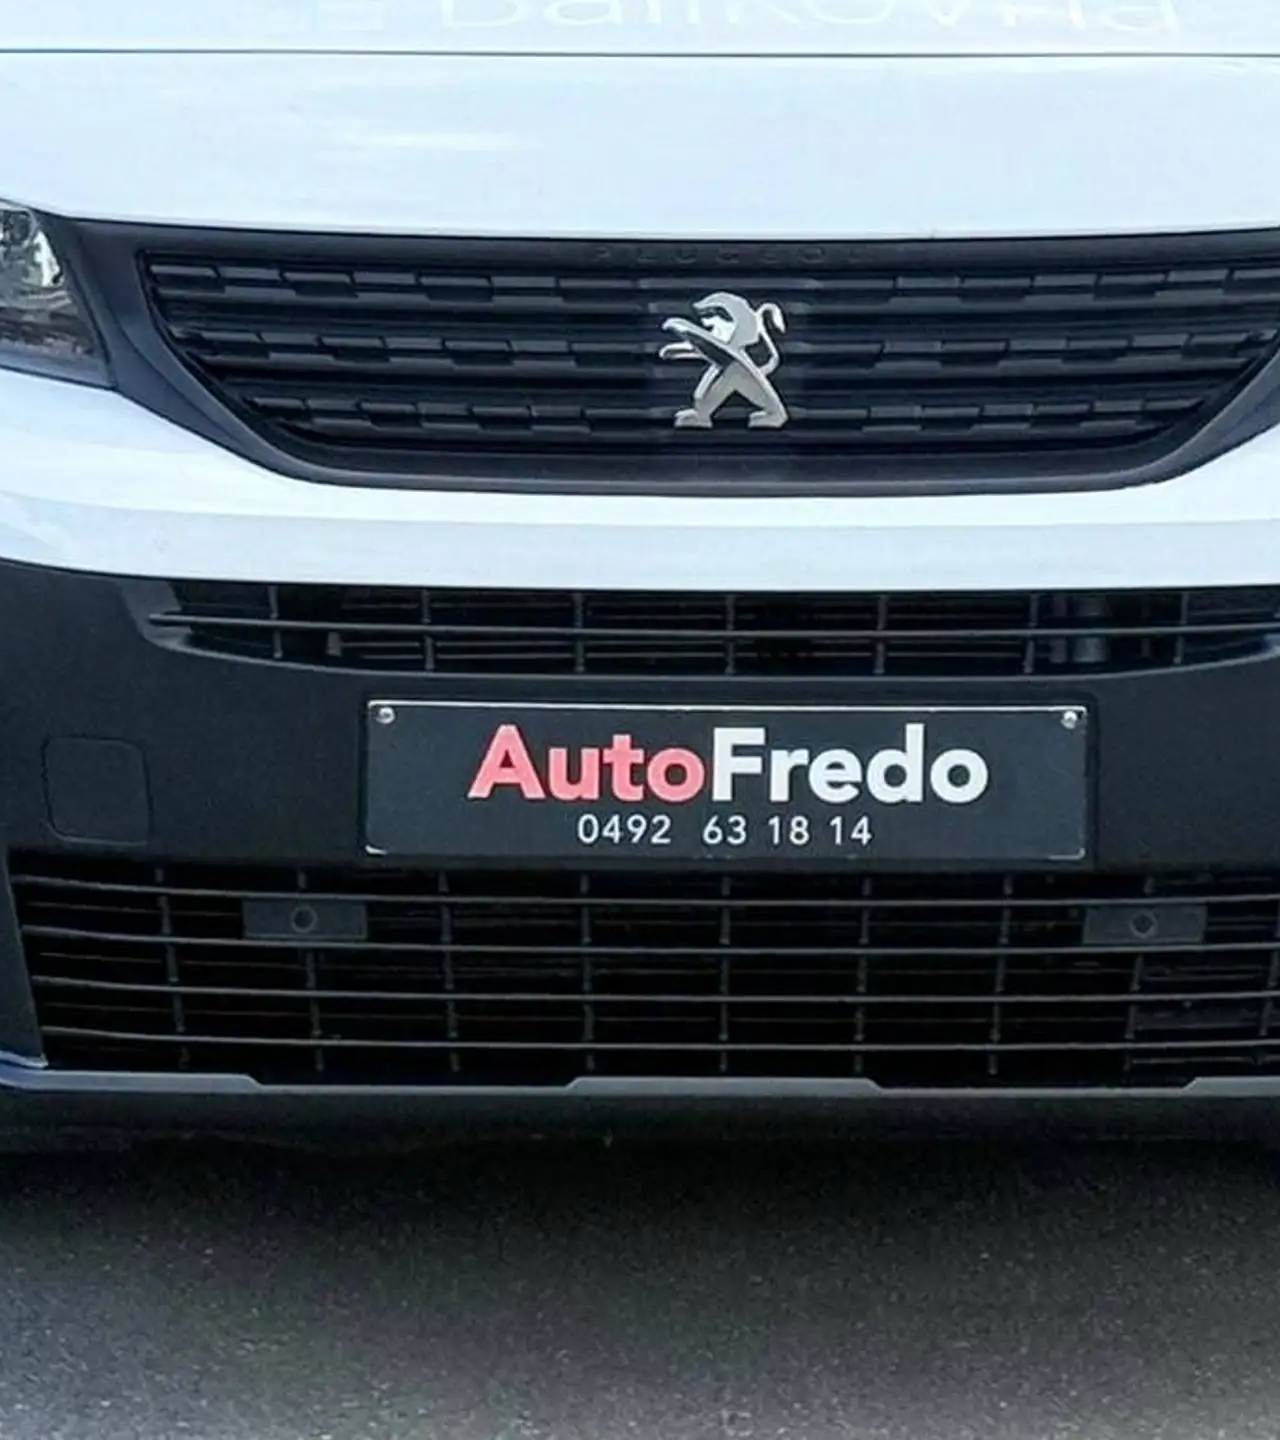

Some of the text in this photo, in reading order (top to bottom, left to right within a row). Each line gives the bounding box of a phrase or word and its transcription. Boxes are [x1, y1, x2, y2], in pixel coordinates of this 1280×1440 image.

[467, 722, 989, 804] AutoFredo
[576, 814, 872, 845] 0492 63 18 14
